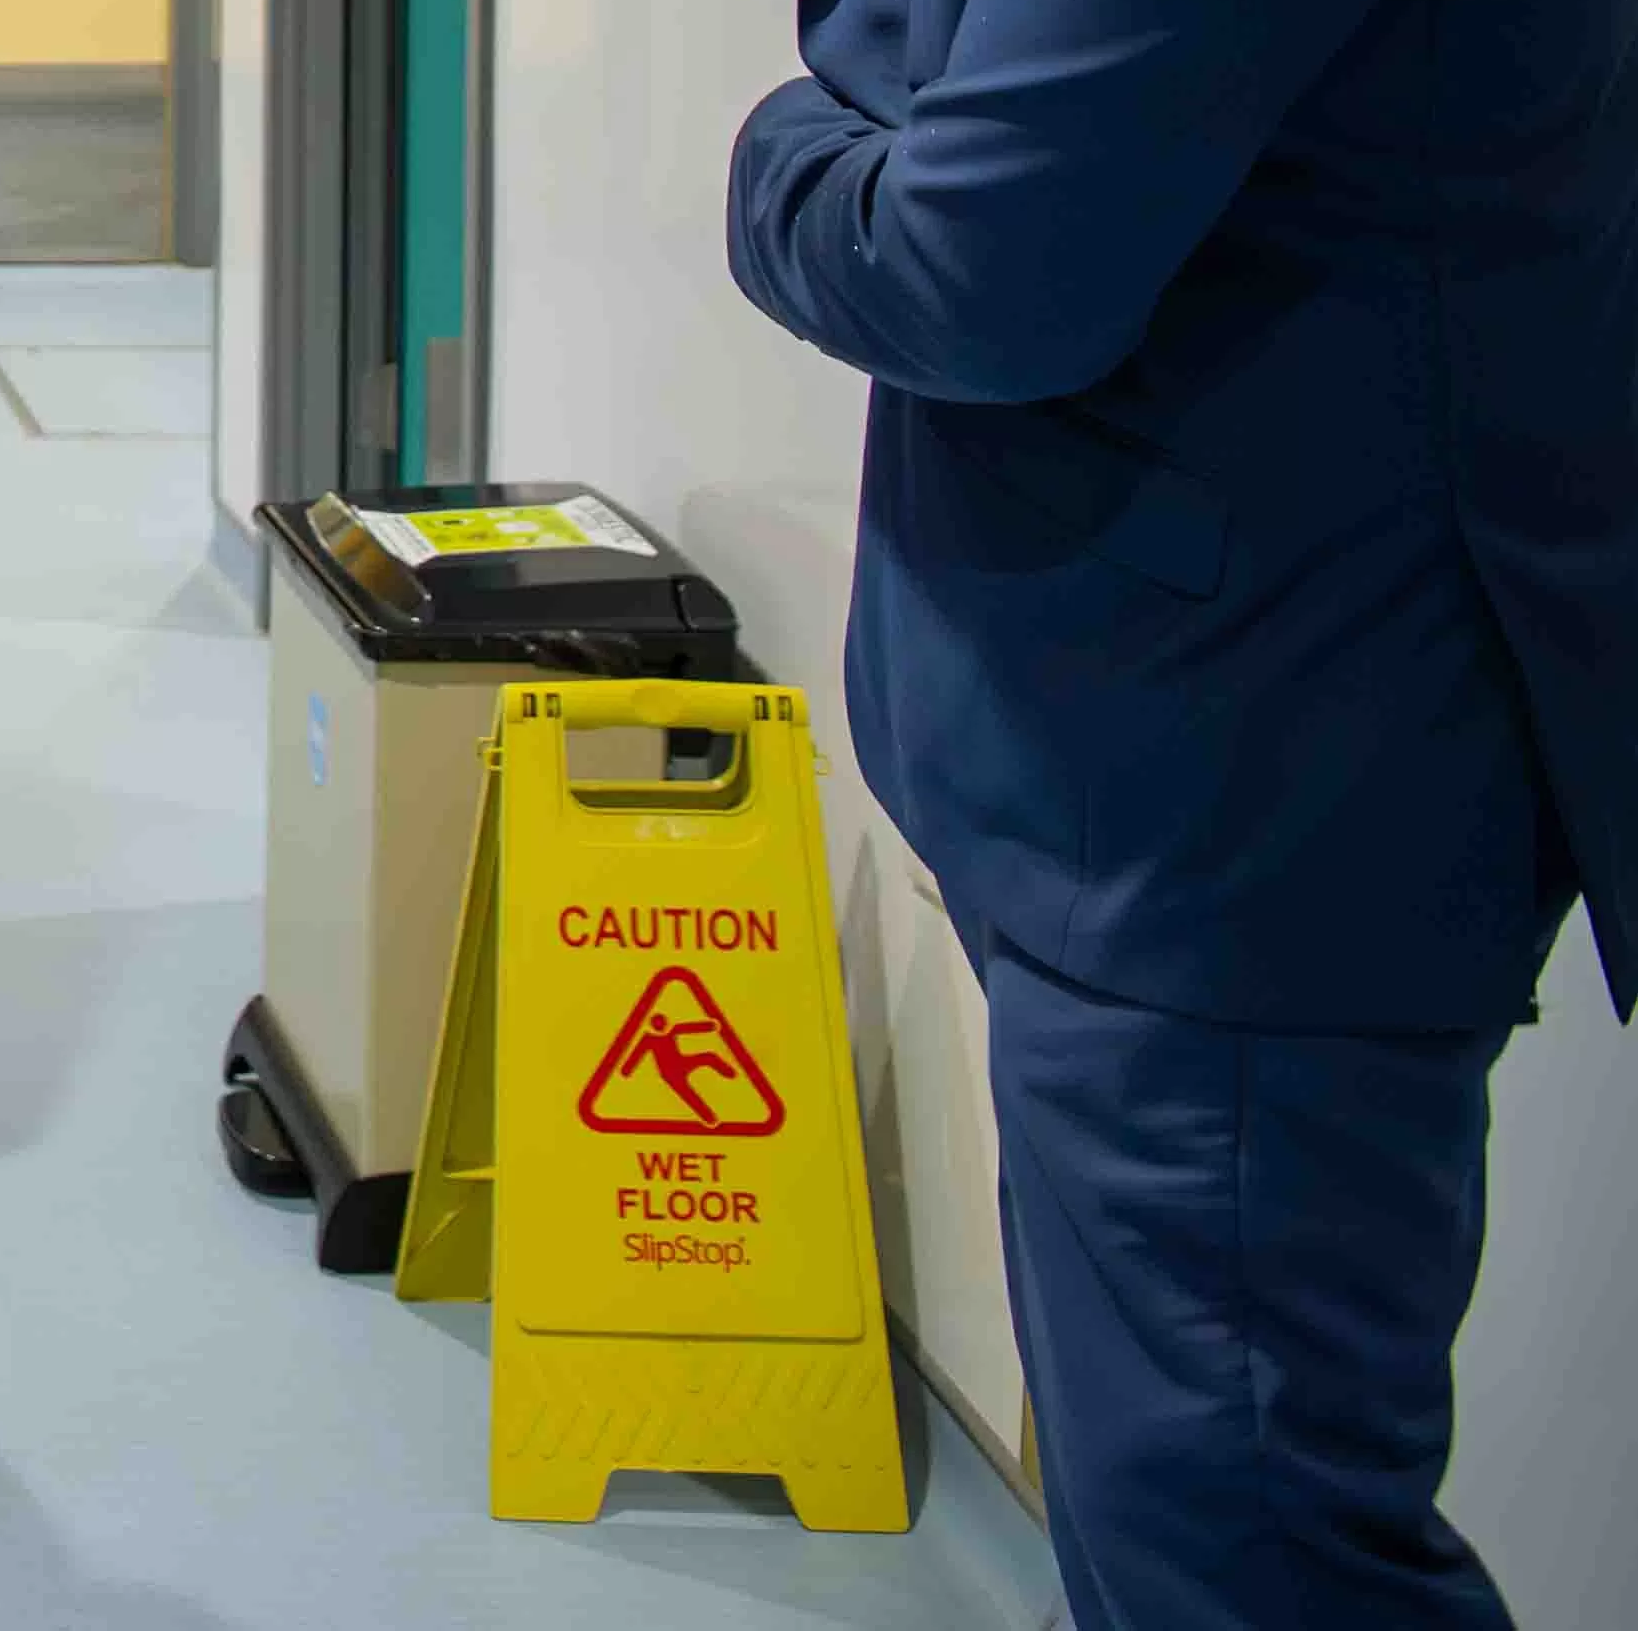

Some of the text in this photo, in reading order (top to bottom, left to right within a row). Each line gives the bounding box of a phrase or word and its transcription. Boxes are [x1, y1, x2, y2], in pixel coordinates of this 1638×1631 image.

[558, 905, 779, 952] CAUTION
[636, 1151, 727, 1183] WET
[616, 1188, 761, 1224] FLOOR
